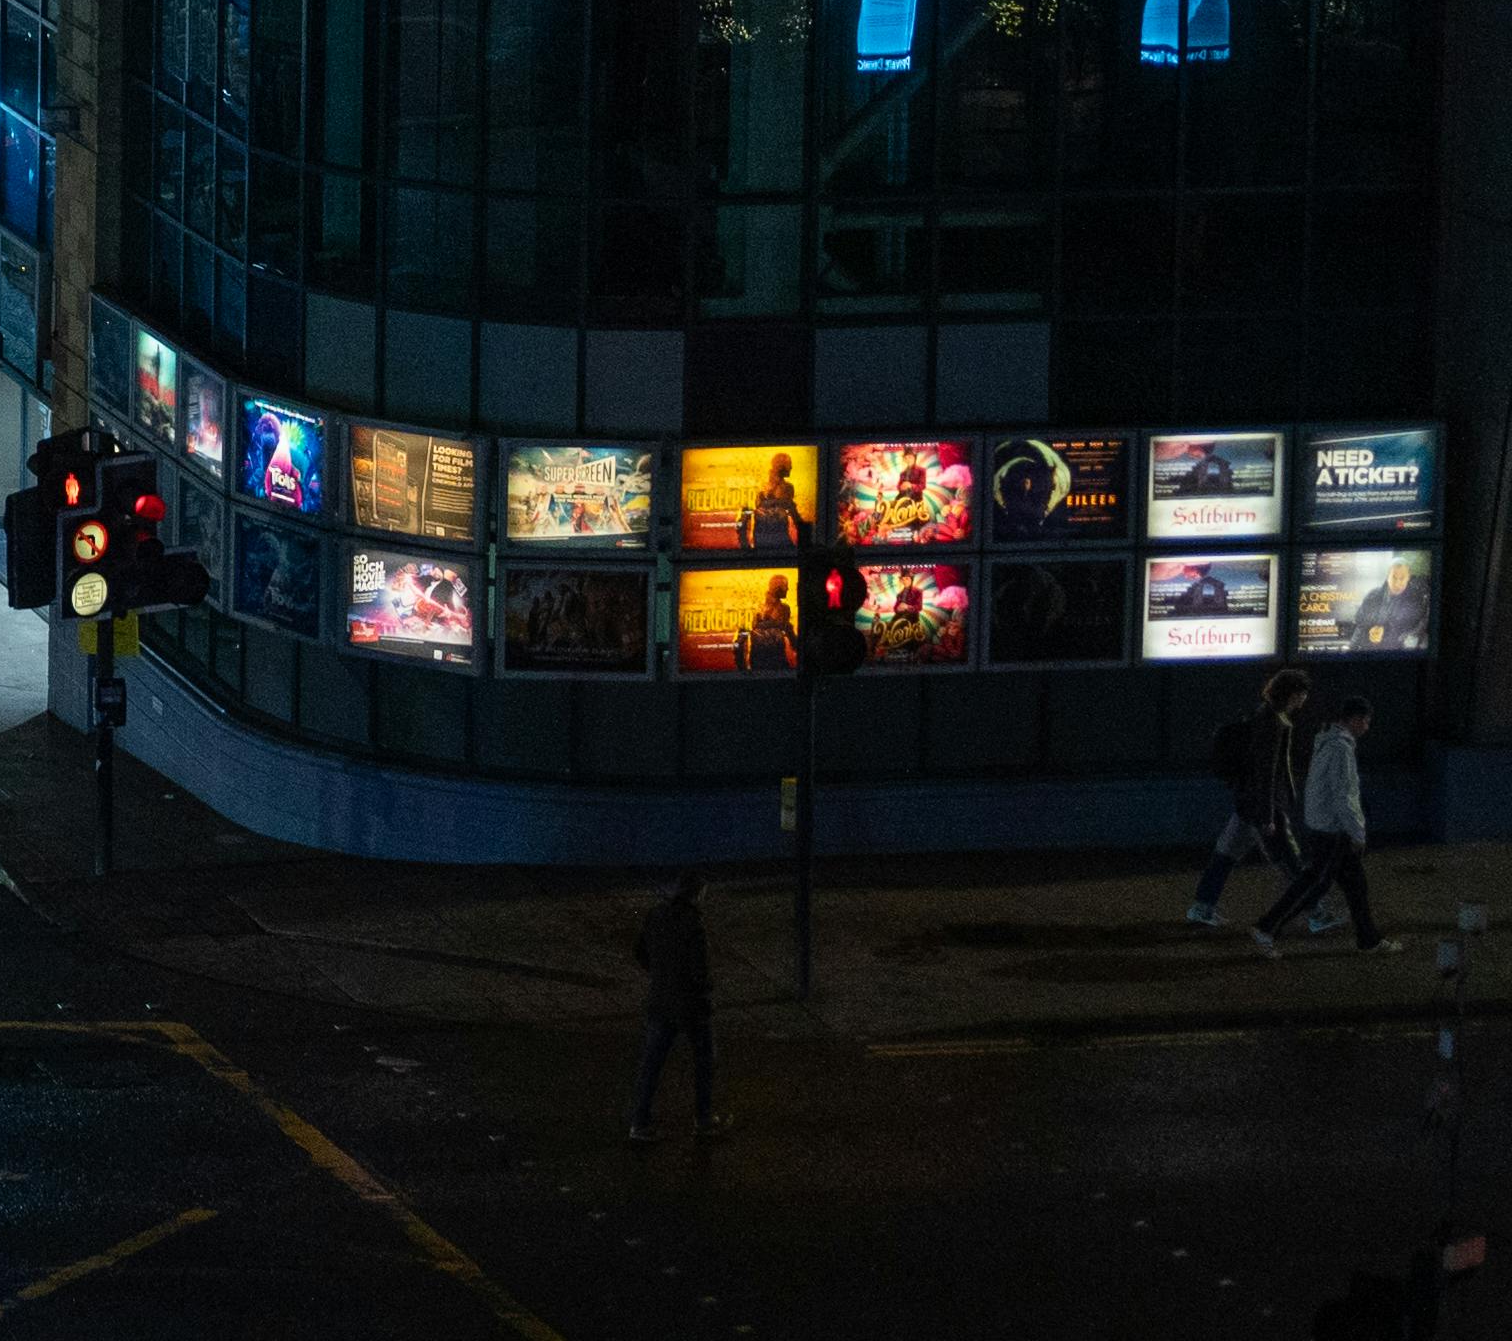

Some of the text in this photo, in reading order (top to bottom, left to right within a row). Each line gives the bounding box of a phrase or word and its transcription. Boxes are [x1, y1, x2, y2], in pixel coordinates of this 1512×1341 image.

[433, 445, 473, 458] LOOKING
[1316, 449, 1374, 467] NEED
[433, 453, 473, 467] FOR FILM
[1316, 466, 1420, 485] A TICKET?
[1171, 504, 1258, 526] Saltburn
[354, 554, 369, 565] SO
[354, 561, 385, 574] MUCH
[353, 570, 386, 583] MOVIE
[353, 580, 386, 592] MAGIC
[1167, 626, 1252, 647] Saltburn
